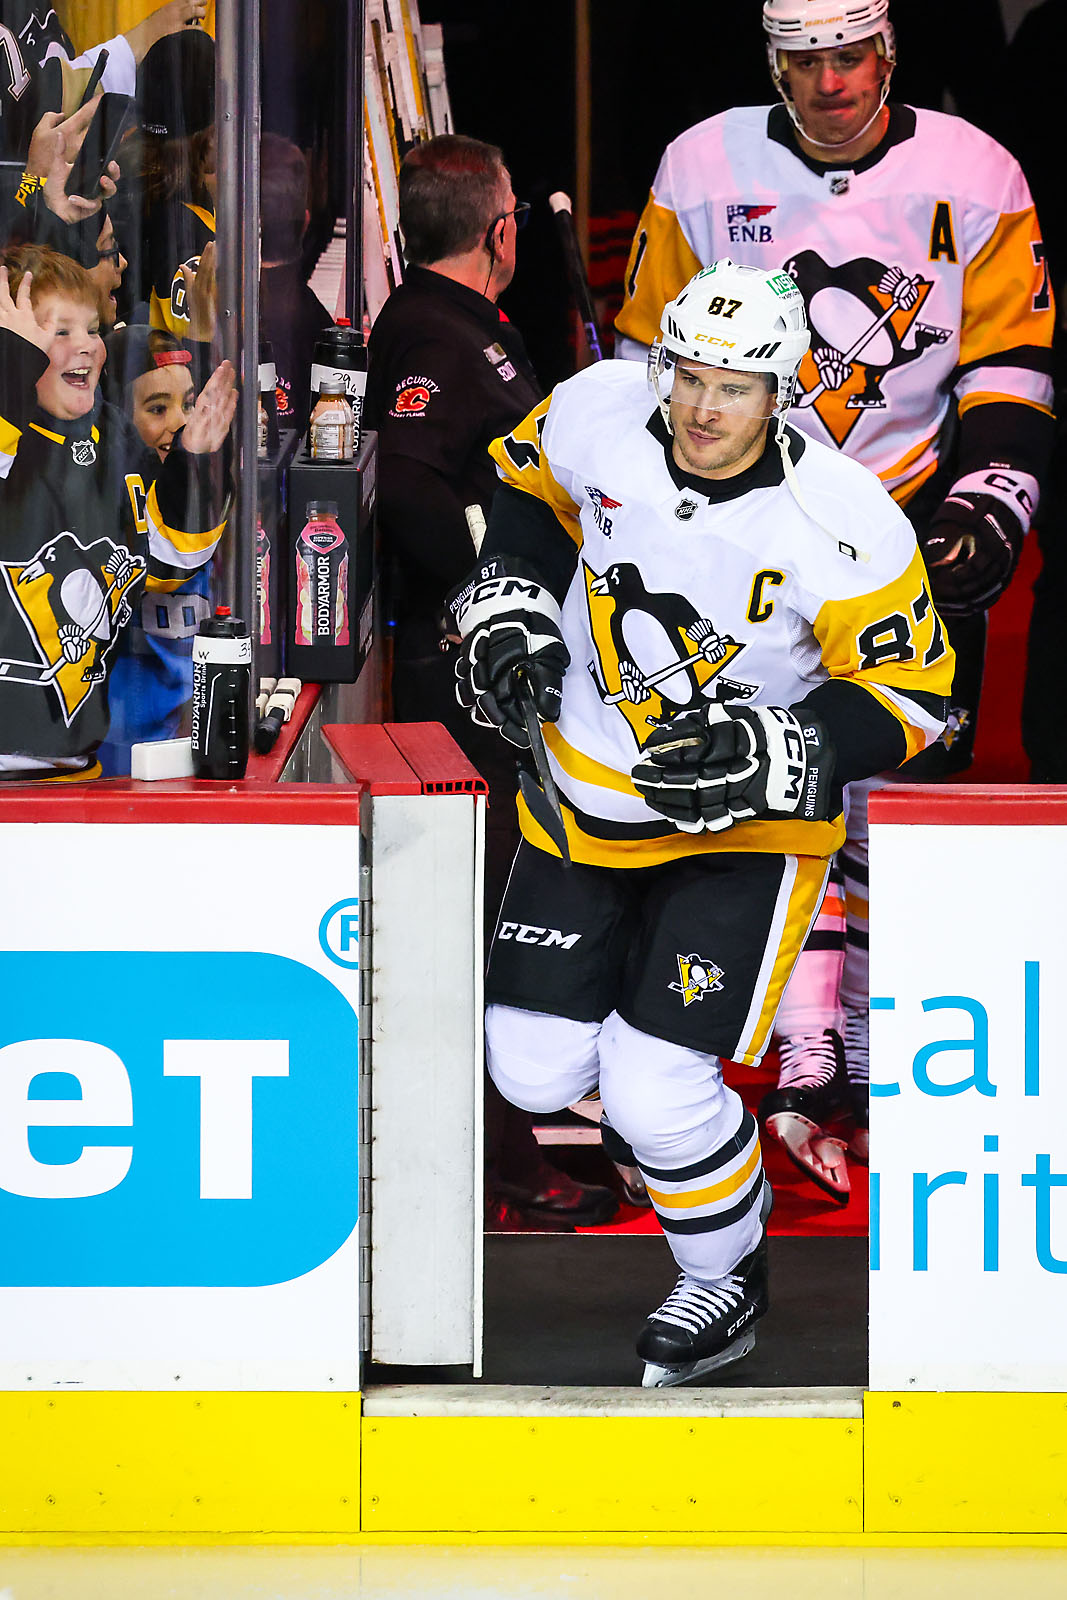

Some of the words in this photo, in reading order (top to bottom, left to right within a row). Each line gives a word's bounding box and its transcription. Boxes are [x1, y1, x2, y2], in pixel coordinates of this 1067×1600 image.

[728, 225, 774, 243] F.N.B.
[928, 200, 960, 265] A
[707, 296, 743, 319] 87
[694, 333, 737, 349] CCM
[395, 376, 441, 394] SECURITY
[480, 561, 498, 580] 87
[317, 556, 331, 636] BODYARMOR
[459, 580, 541, 623] CCM
[745, 568, 787, 624] C
[198, 650, 210, 660] W
[803, 727, 820, 748] 87
[766, 705, 804, 801] CCM
[804, 767, 819, 818] PENGUINS
[498, 921, 582, 950] CCM
